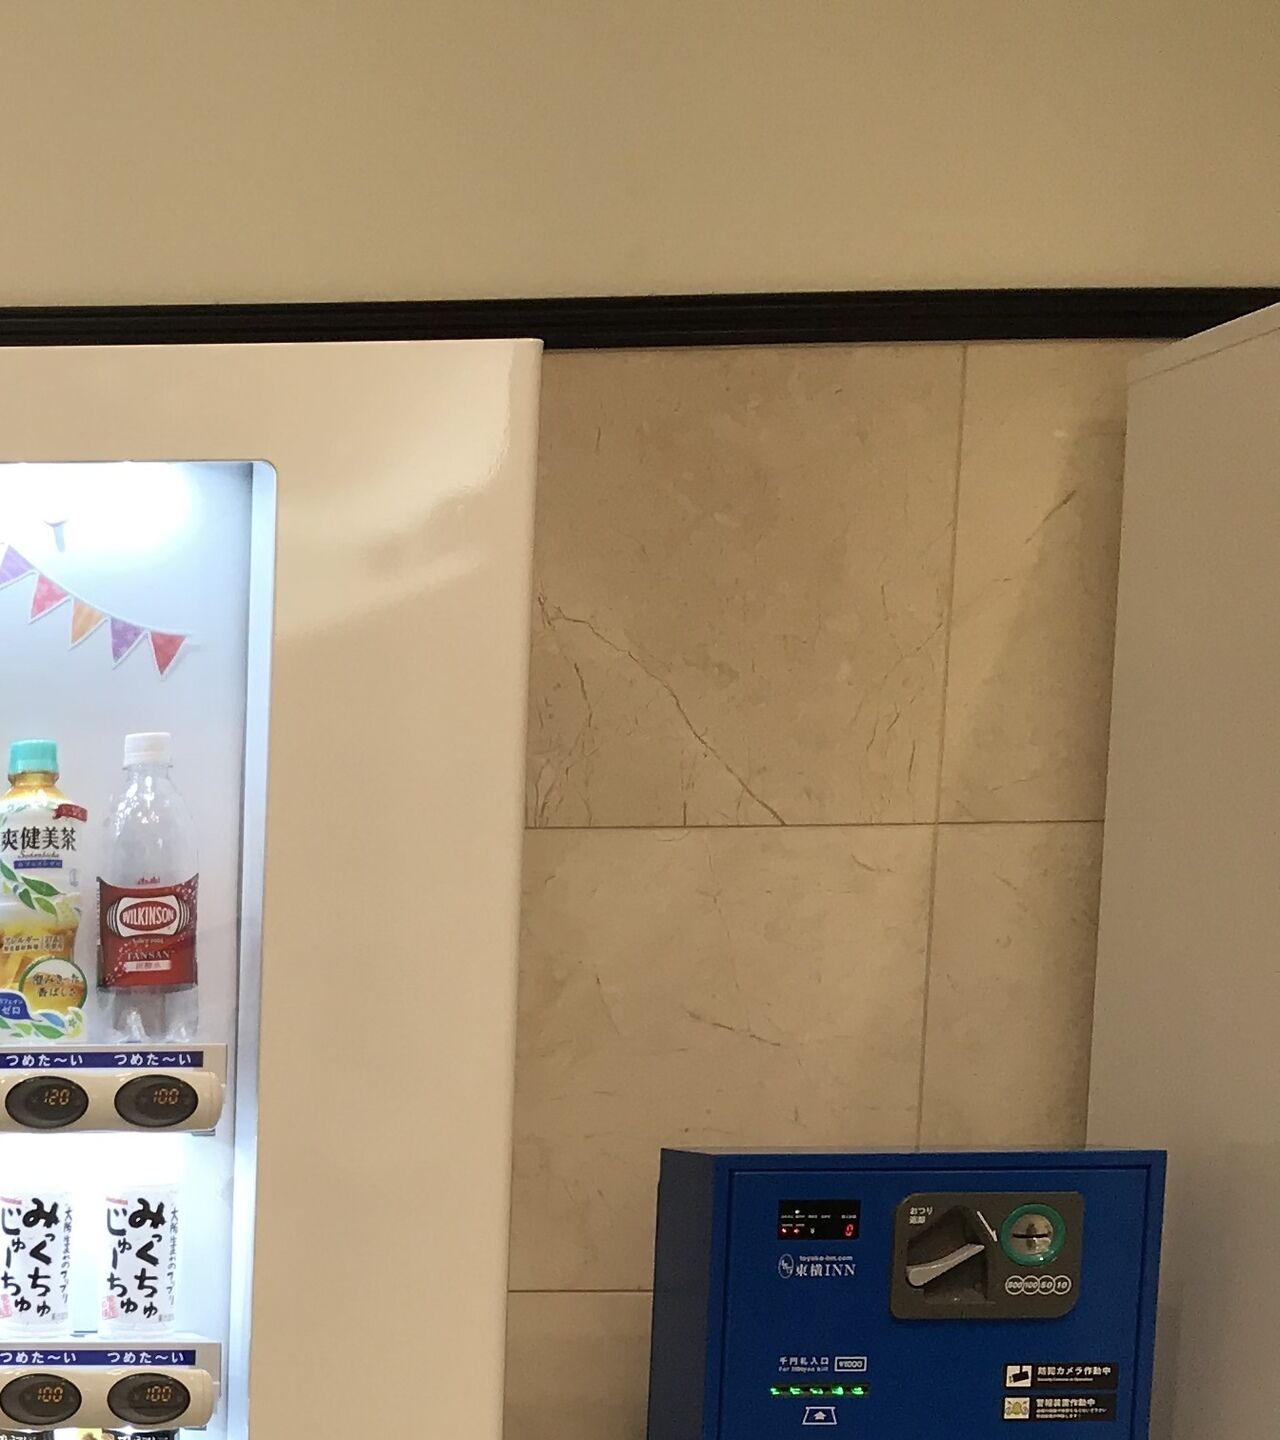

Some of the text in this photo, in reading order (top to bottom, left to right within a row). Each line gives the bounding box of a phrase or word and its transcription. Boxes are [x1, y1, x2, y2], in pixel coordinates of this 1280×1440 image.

[1, 826, 77, 852] 爽健美茶
[122, 905, 175, 924] WILKINSON
[1, 1005, 22, 1016] ゼロ
[909, 1205, 934, 1216] おつり
[795, 1263, 856, 1277] 東横INN
[36, 1386, 64, 1403] 100
